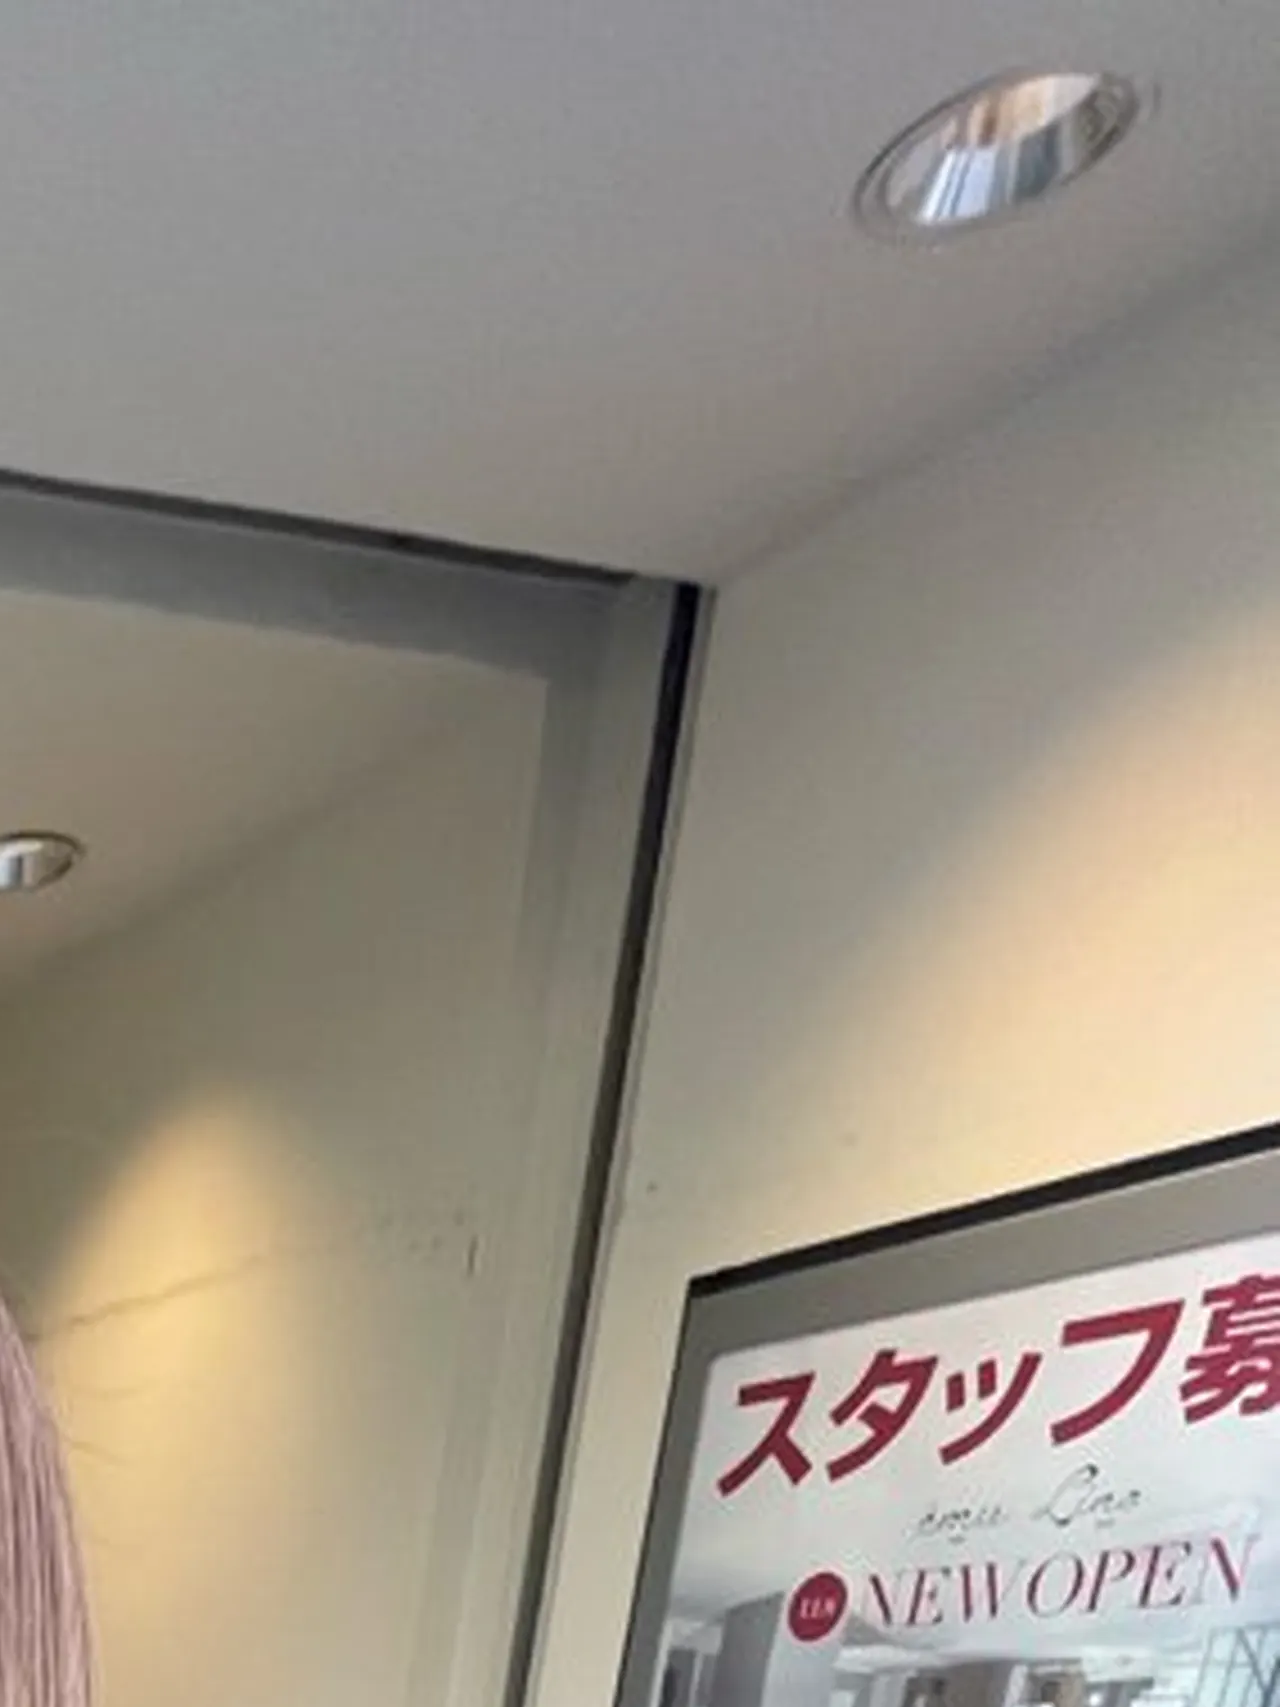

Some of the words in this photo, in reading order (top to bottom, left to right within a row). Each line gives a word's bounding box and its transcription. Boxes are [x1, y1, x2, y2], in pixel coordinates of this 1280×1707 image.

[716, 1273, 1280, 1498] スタッフ募
